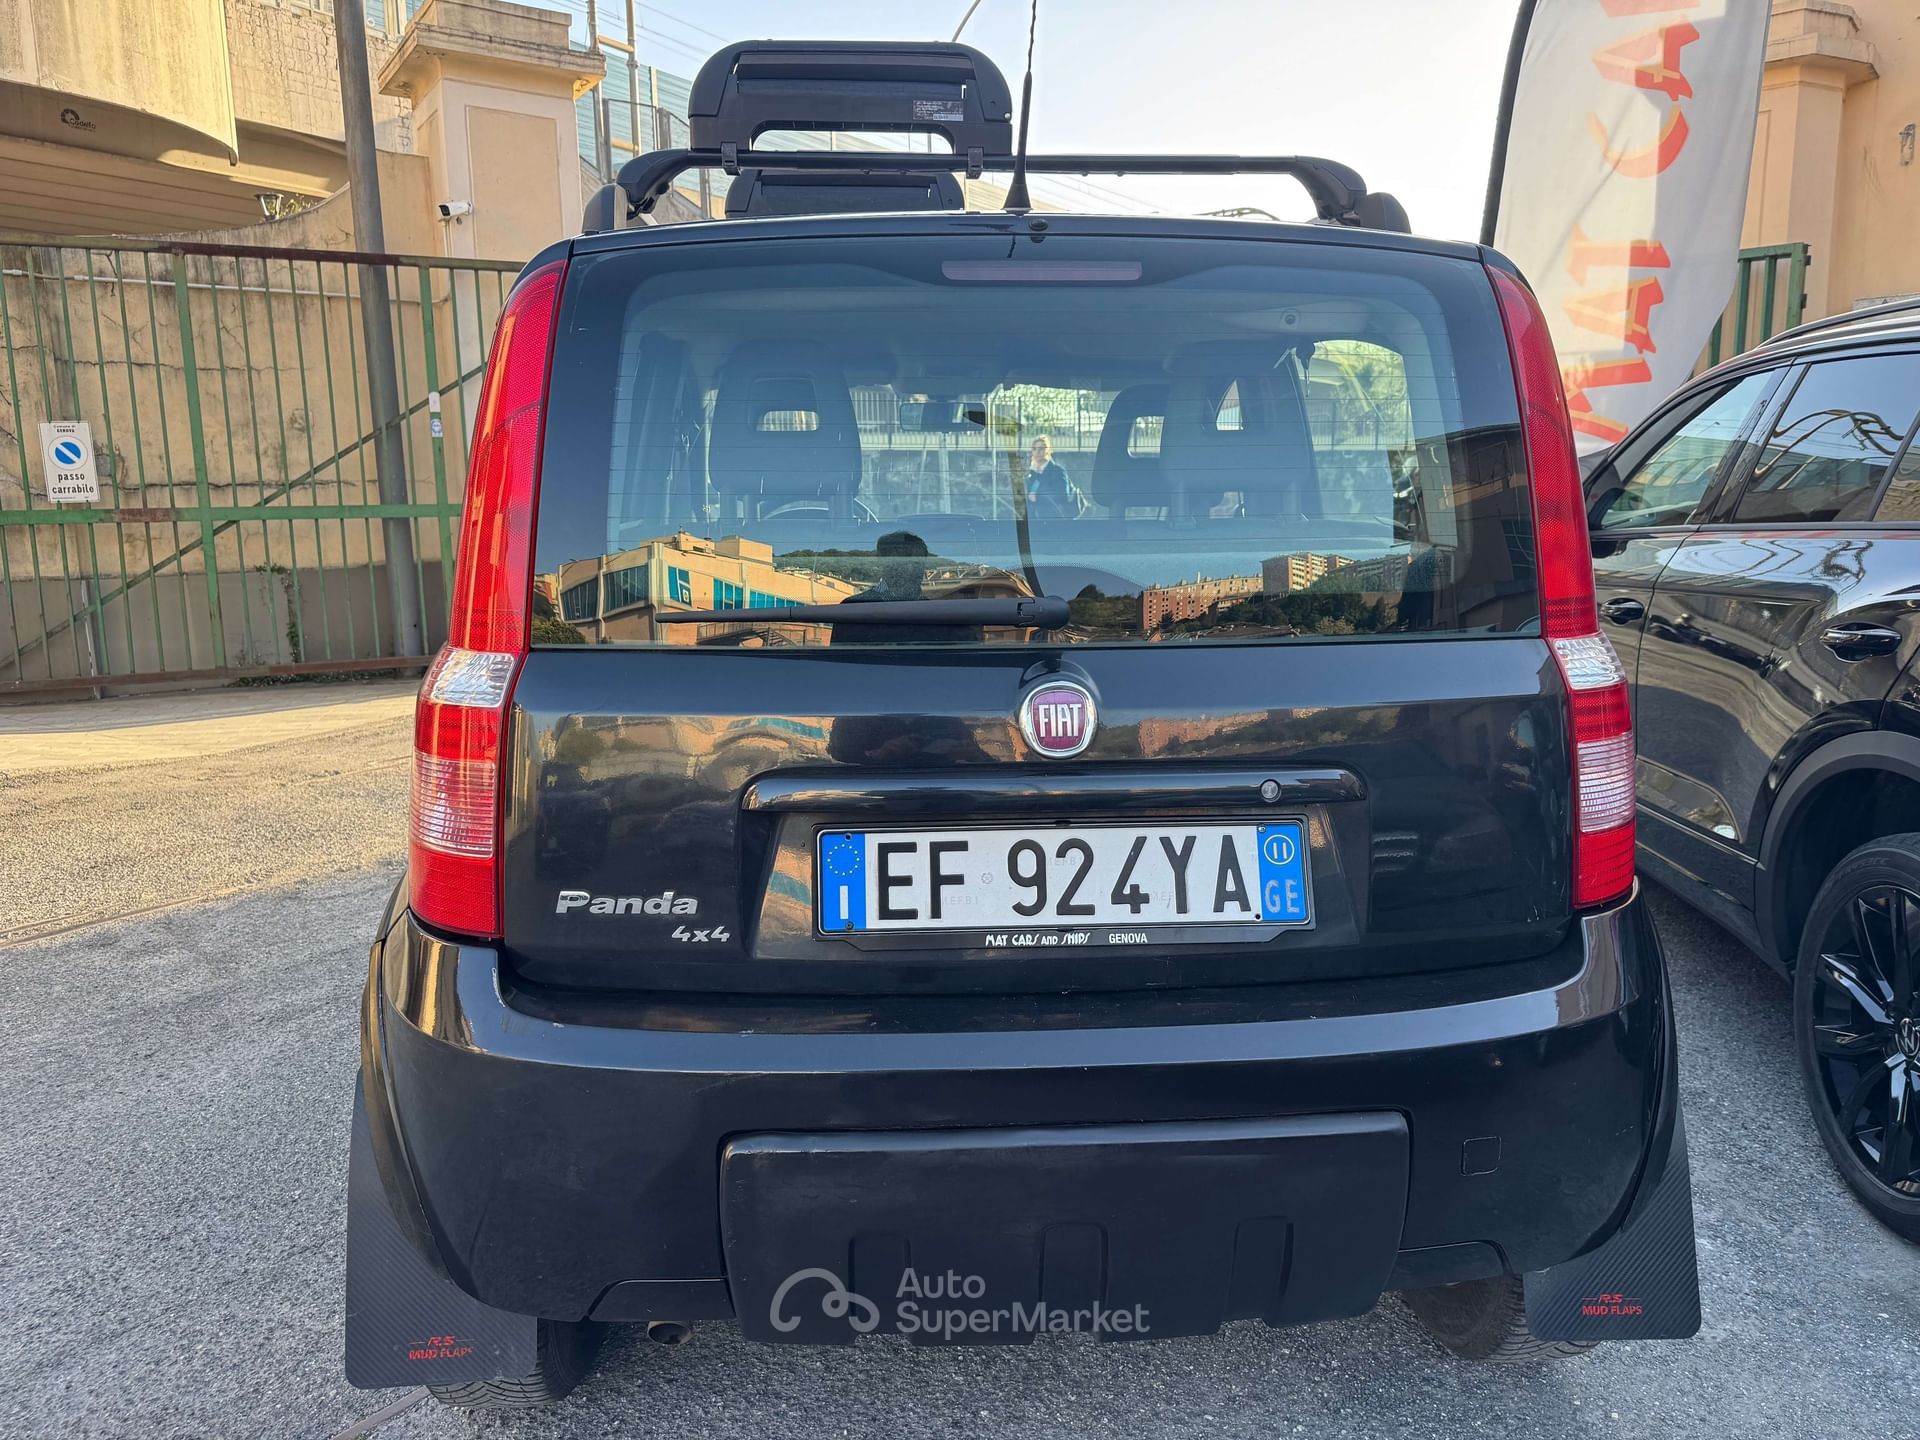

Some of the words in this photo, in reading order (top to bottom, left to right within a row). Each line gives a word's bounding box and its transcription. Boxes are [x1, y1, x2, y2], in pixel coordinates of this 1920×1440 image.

[1587, 0, 1701, 178] CA
[57, 473, 85, 483] passo
[52, 484, 95, 494] carrabile
[1038, 703, 1082, 738] FIAT
[878, 840, 969, 921] EF
[1006, 834, 1252, 917] 924YA
[555, 890, 698, 915] Panda
[839, 885, 849, 920] I
[1264, 878, 1300, 914] GE
[671, 925, 730, 942] 4x4
[985, 934, 1009, 947] MAT
[1011, 933, 1040, 947] CARS
[1060, 932, 1091, 945] SHIPS
[1108, 932, 1149, 945] GENOVA
[1583, 1305, 1609, 1316] MUD
[1611, 1305, 1642, 1316] FLAPS
[408, 1349, 438, 1360] MUD
